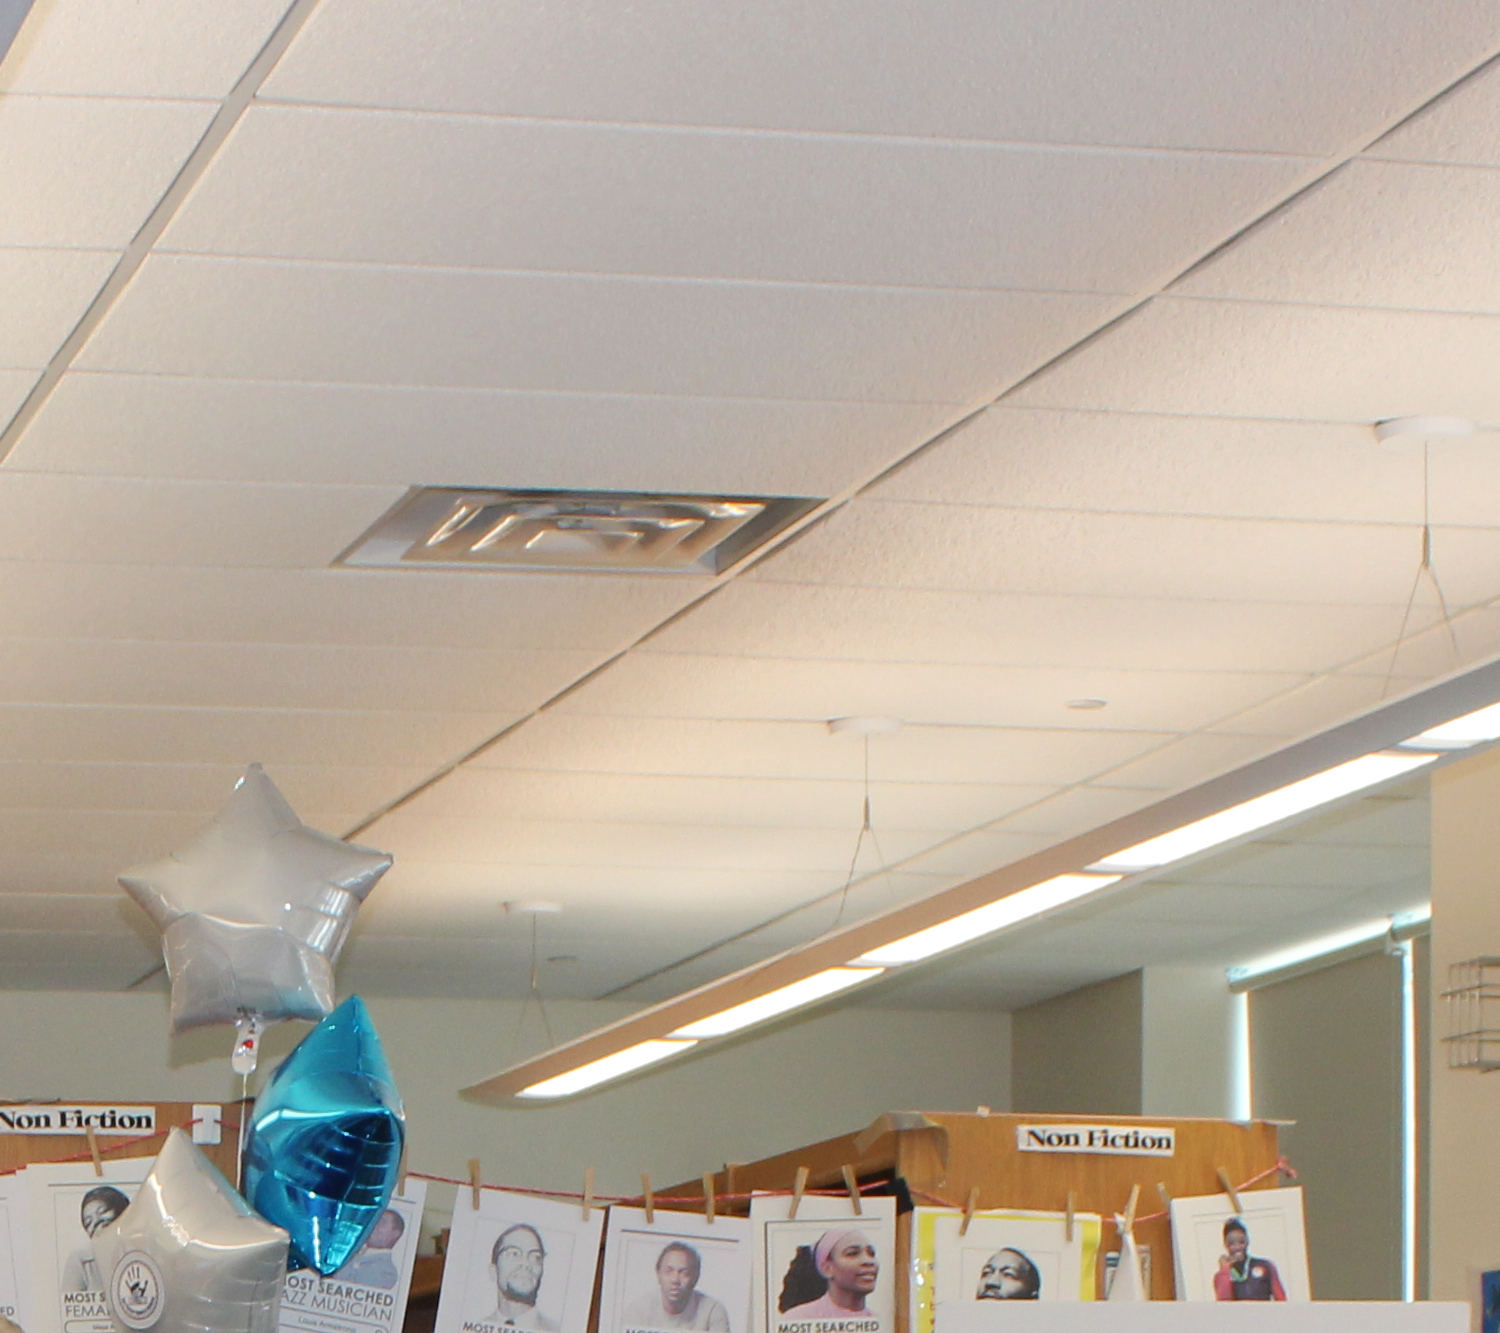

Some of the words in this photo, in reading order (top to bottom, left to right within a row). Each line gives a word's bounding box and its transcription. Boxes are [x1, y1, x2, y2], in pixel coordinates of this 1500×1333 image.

[57, 1108, 154, 1131] Fiction
[1026, 1129, 1085, 1149] Non
[1092, 1130, 1173, 1152] Fiction
[63, 1291, 97, 1304] MOST
[284, 1275, 315, 1291] OST
[317, 1280, 394, 1307] SEARCHED
[281, 1290, 307, 1306] AZZ
[310, 1295, 392, 1321] MUSICIAN
[815, 1320, 880, 1333] SEARCHED
